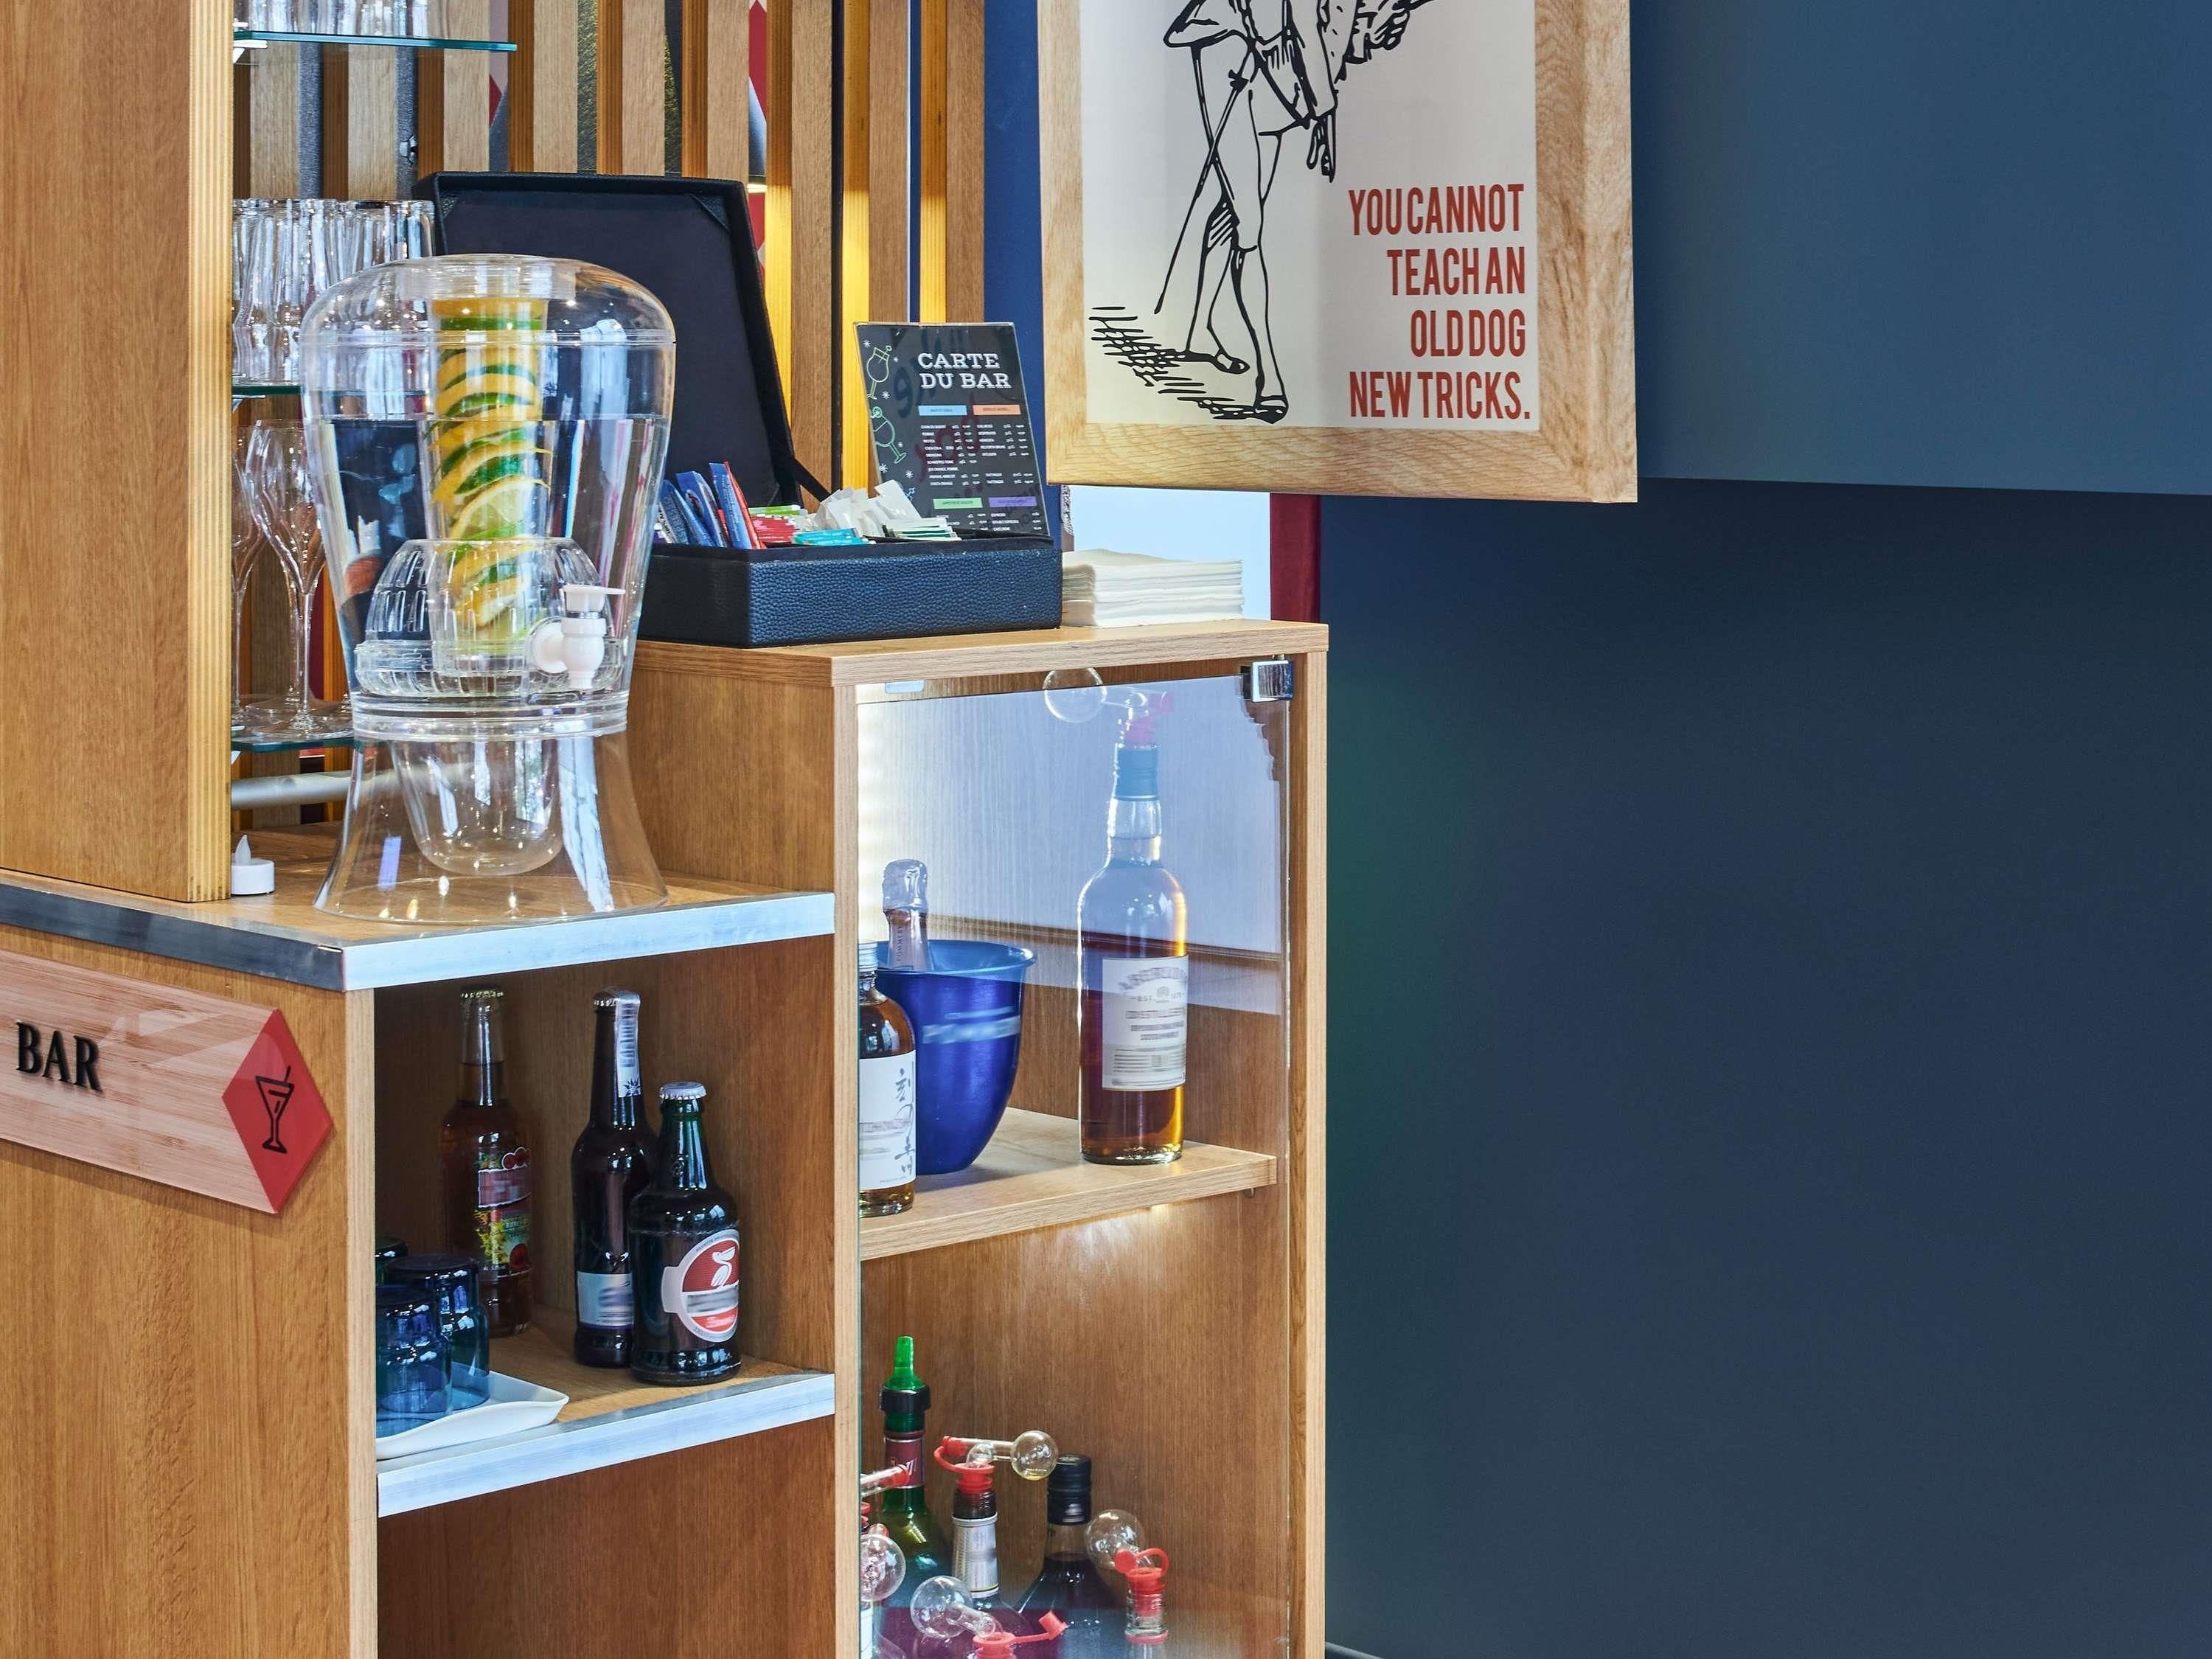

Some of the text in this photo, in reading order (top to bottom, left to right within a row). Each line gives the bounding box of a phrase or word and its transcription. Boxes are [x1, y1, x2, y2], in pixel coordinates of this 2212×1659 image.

[1348, 184, 1524, 236] YOU CANNOT
[1387, 246, 1525, 296] TEACH AN
[1411, 309, 1526, 357] OLD DOG
[917, 352, 1000, 369] CARTE
[919, 373, 1012, 389] DU BAR
[1349, 371, 1530, 419] NEW TRICKS.
[16, 1022, 103, 1093] BAR
